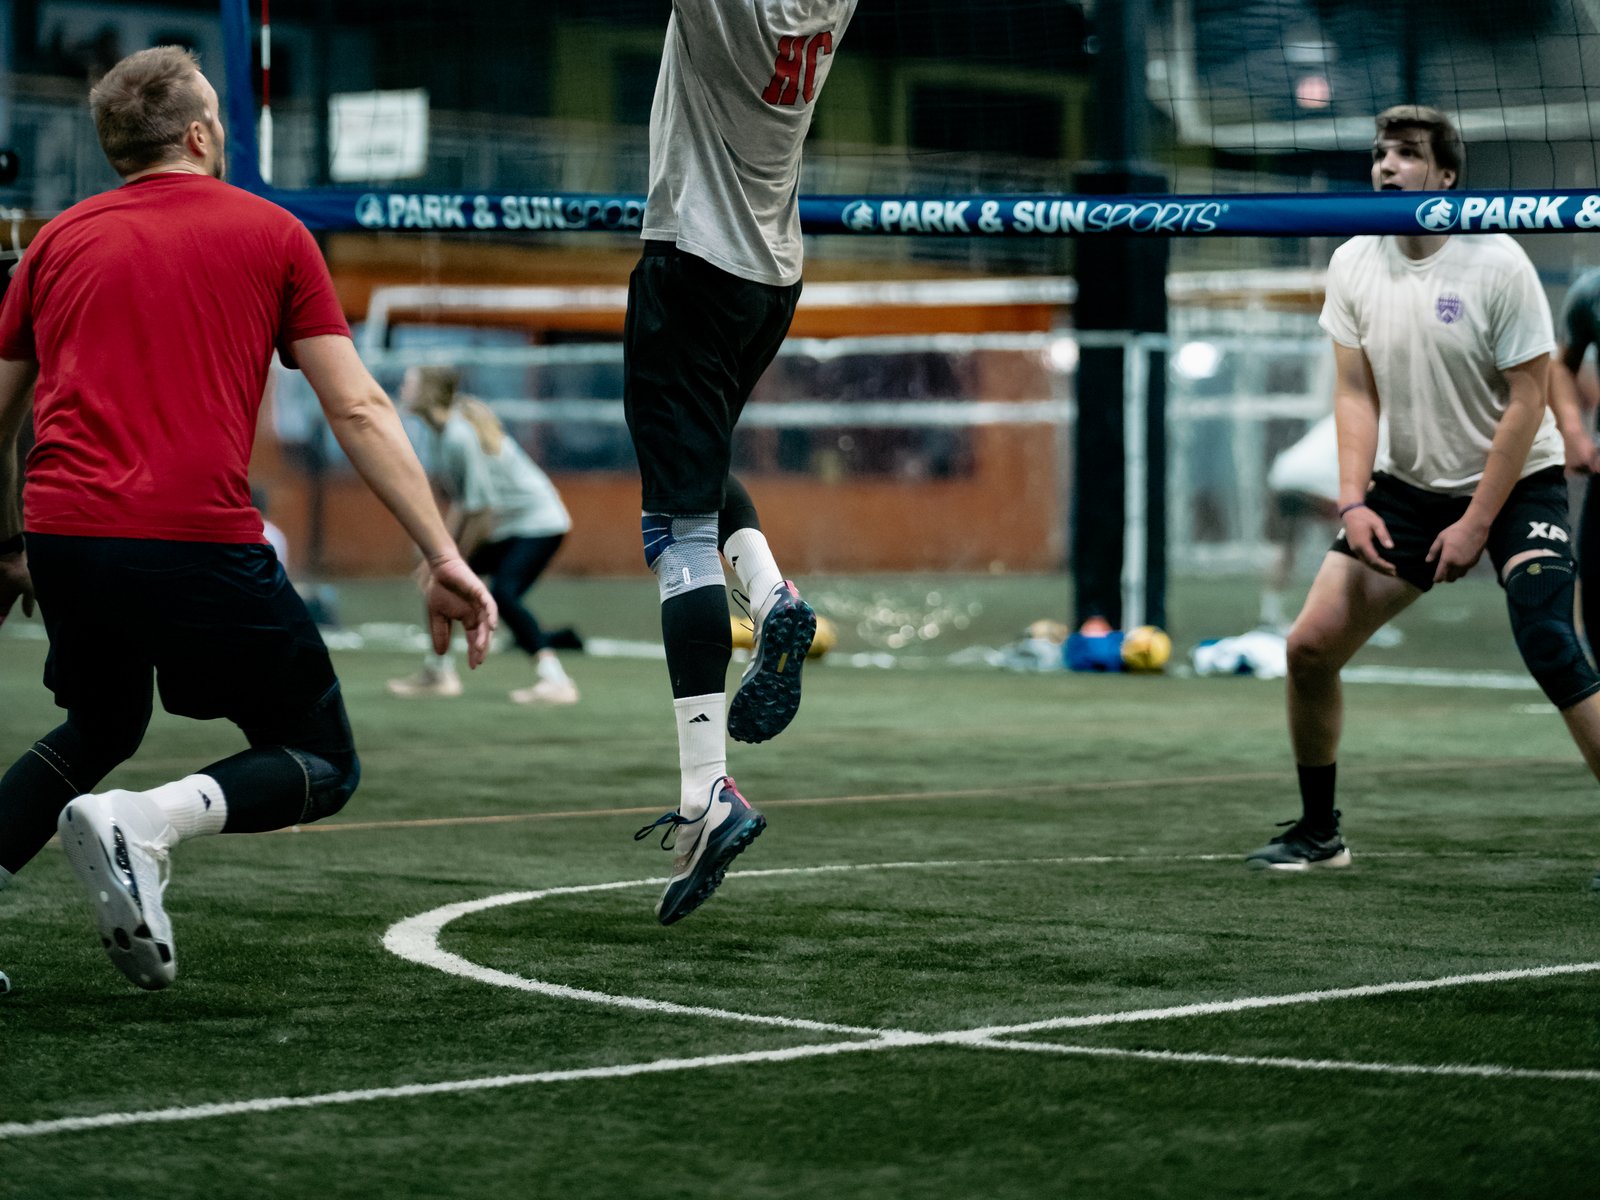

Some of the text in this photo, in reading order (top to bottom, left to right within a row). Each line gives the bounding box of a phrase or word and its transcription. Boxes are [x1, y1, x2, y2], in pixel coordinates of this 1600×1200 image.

[387, 194, 646, 229] PARK & SUN SPOR
[879, 200, 1220, 234] PARK & SUN SPORTS
[1460, 194, 1600, 230] PARK &
